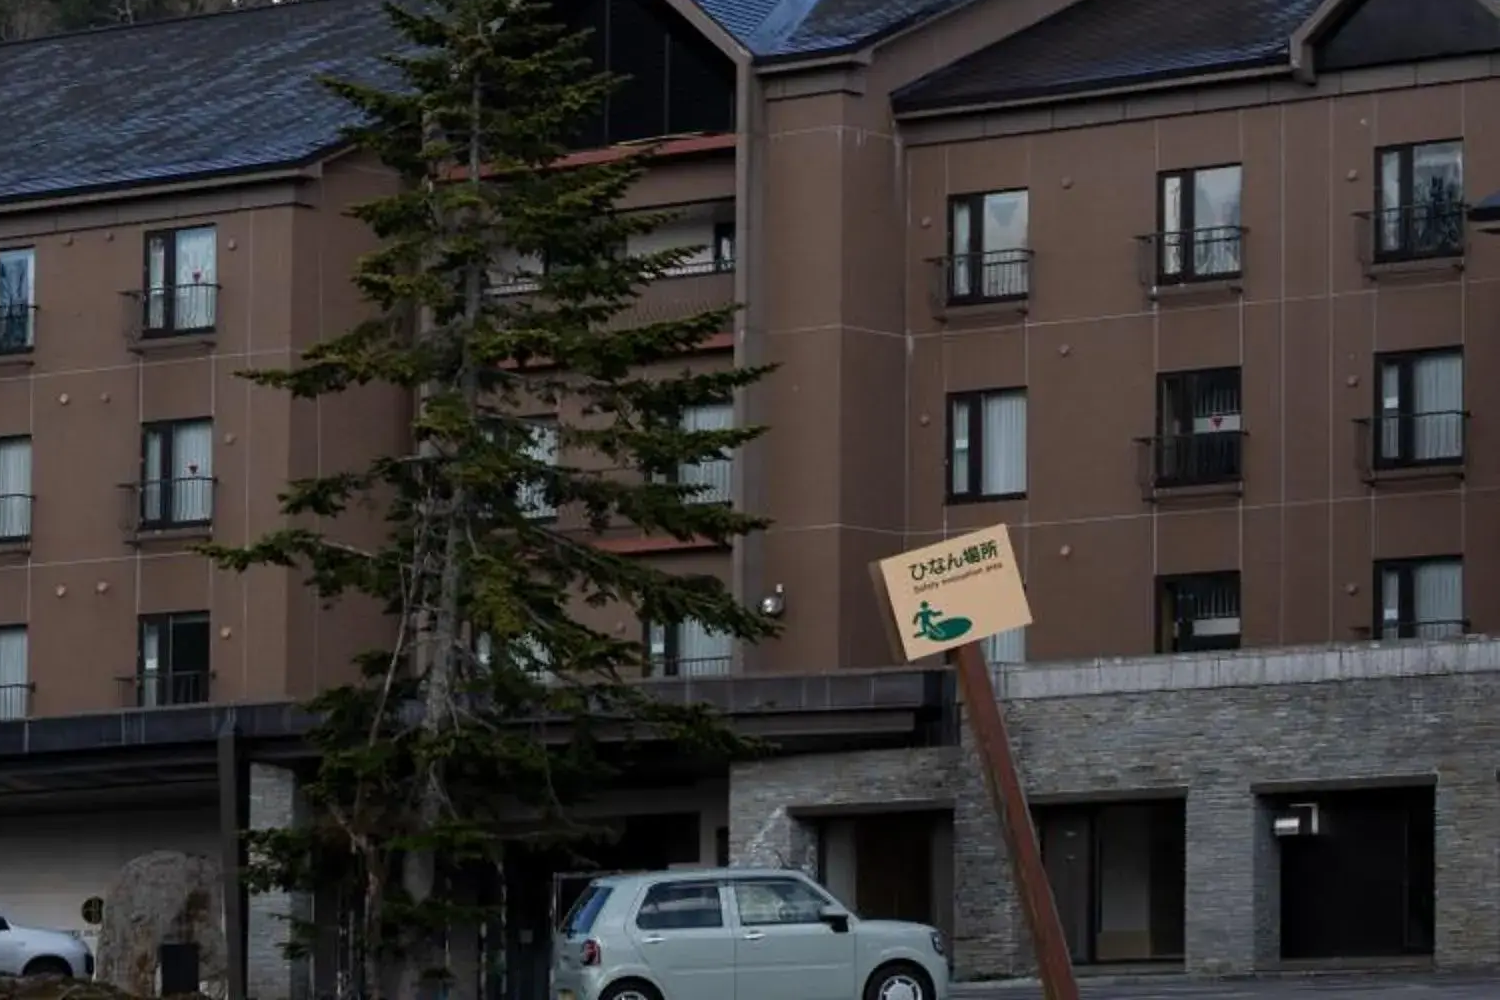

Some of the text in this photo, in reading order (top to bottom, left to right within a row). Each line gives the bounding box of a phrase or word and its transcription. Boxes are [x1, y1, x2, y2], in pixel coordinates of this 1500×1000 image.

[908, 540, 998, 581] ひなん場所
